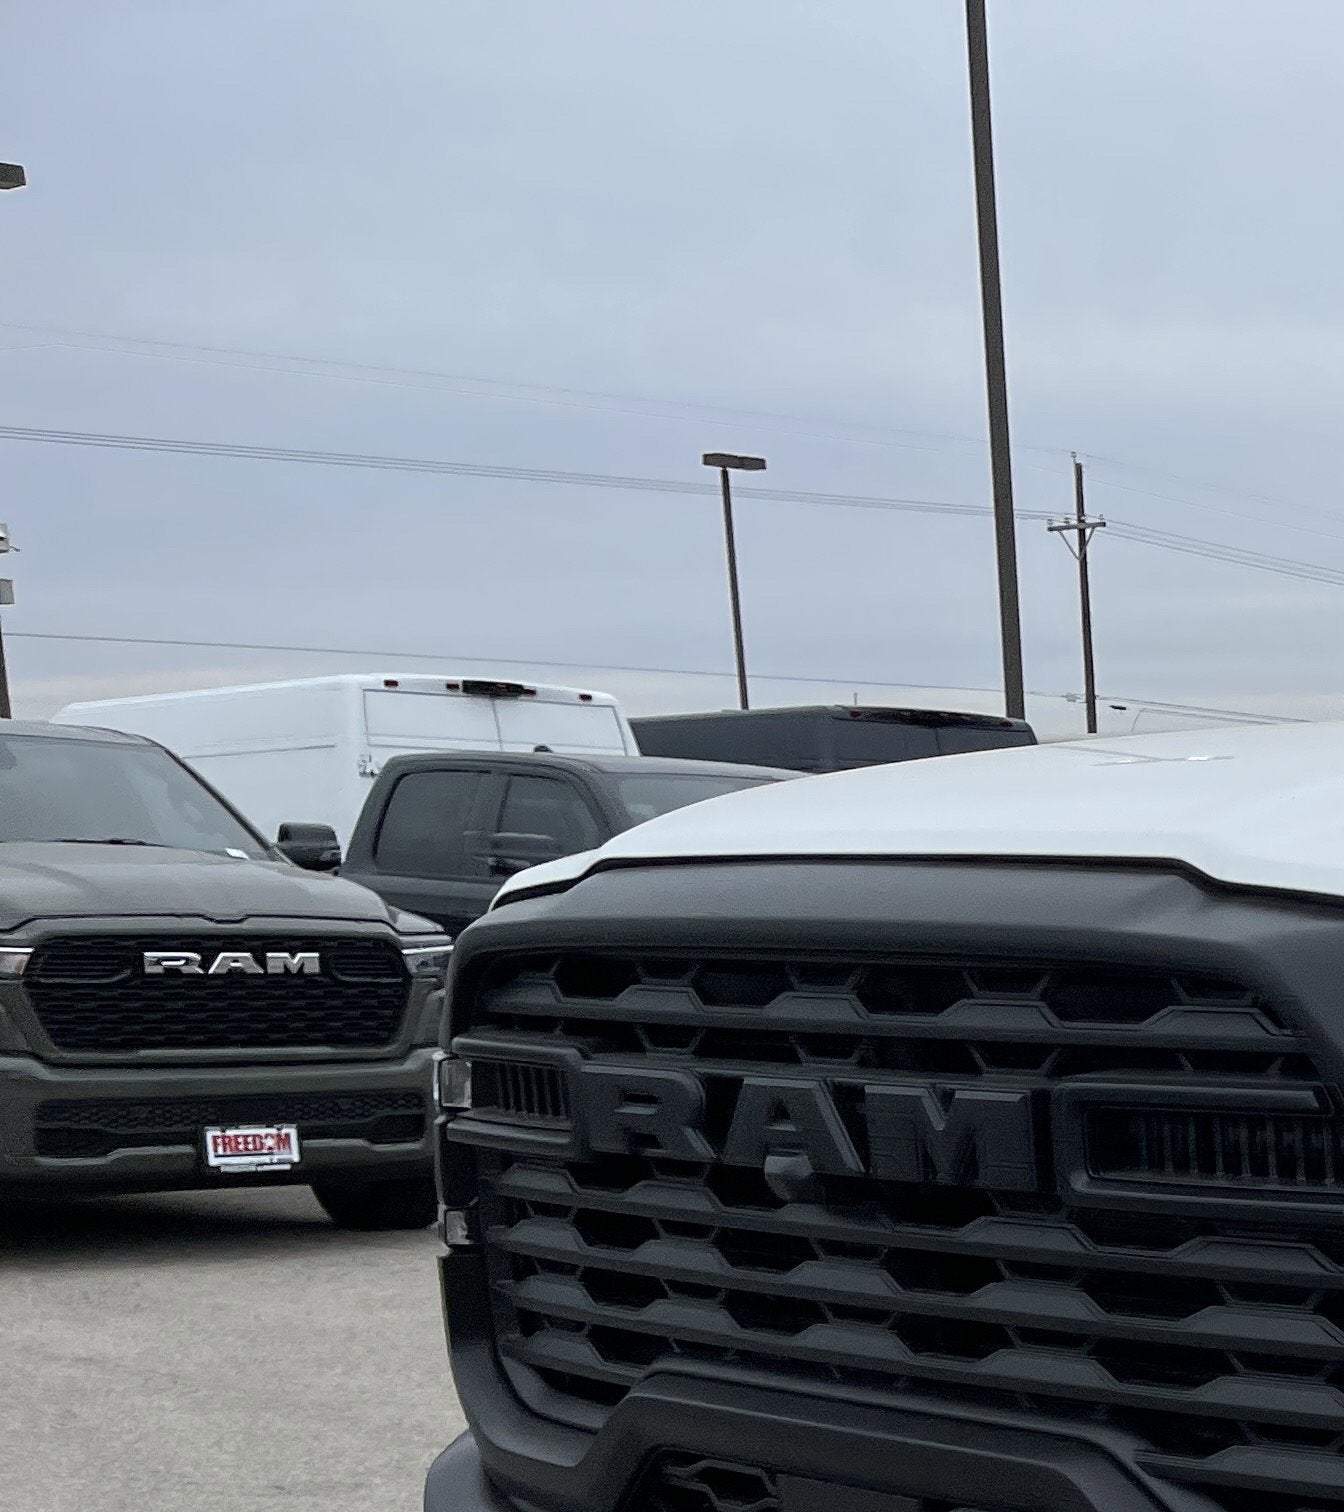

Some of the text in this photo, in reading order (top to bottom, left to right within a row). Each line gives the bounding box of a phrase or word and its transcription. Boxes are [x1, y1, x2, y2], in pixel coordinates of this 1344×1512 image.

[144, 952, 321, 974] RAM
[580, 1064, 1036, 1189] RAM
[212, 1133, 291, 1153] FREEDOM
